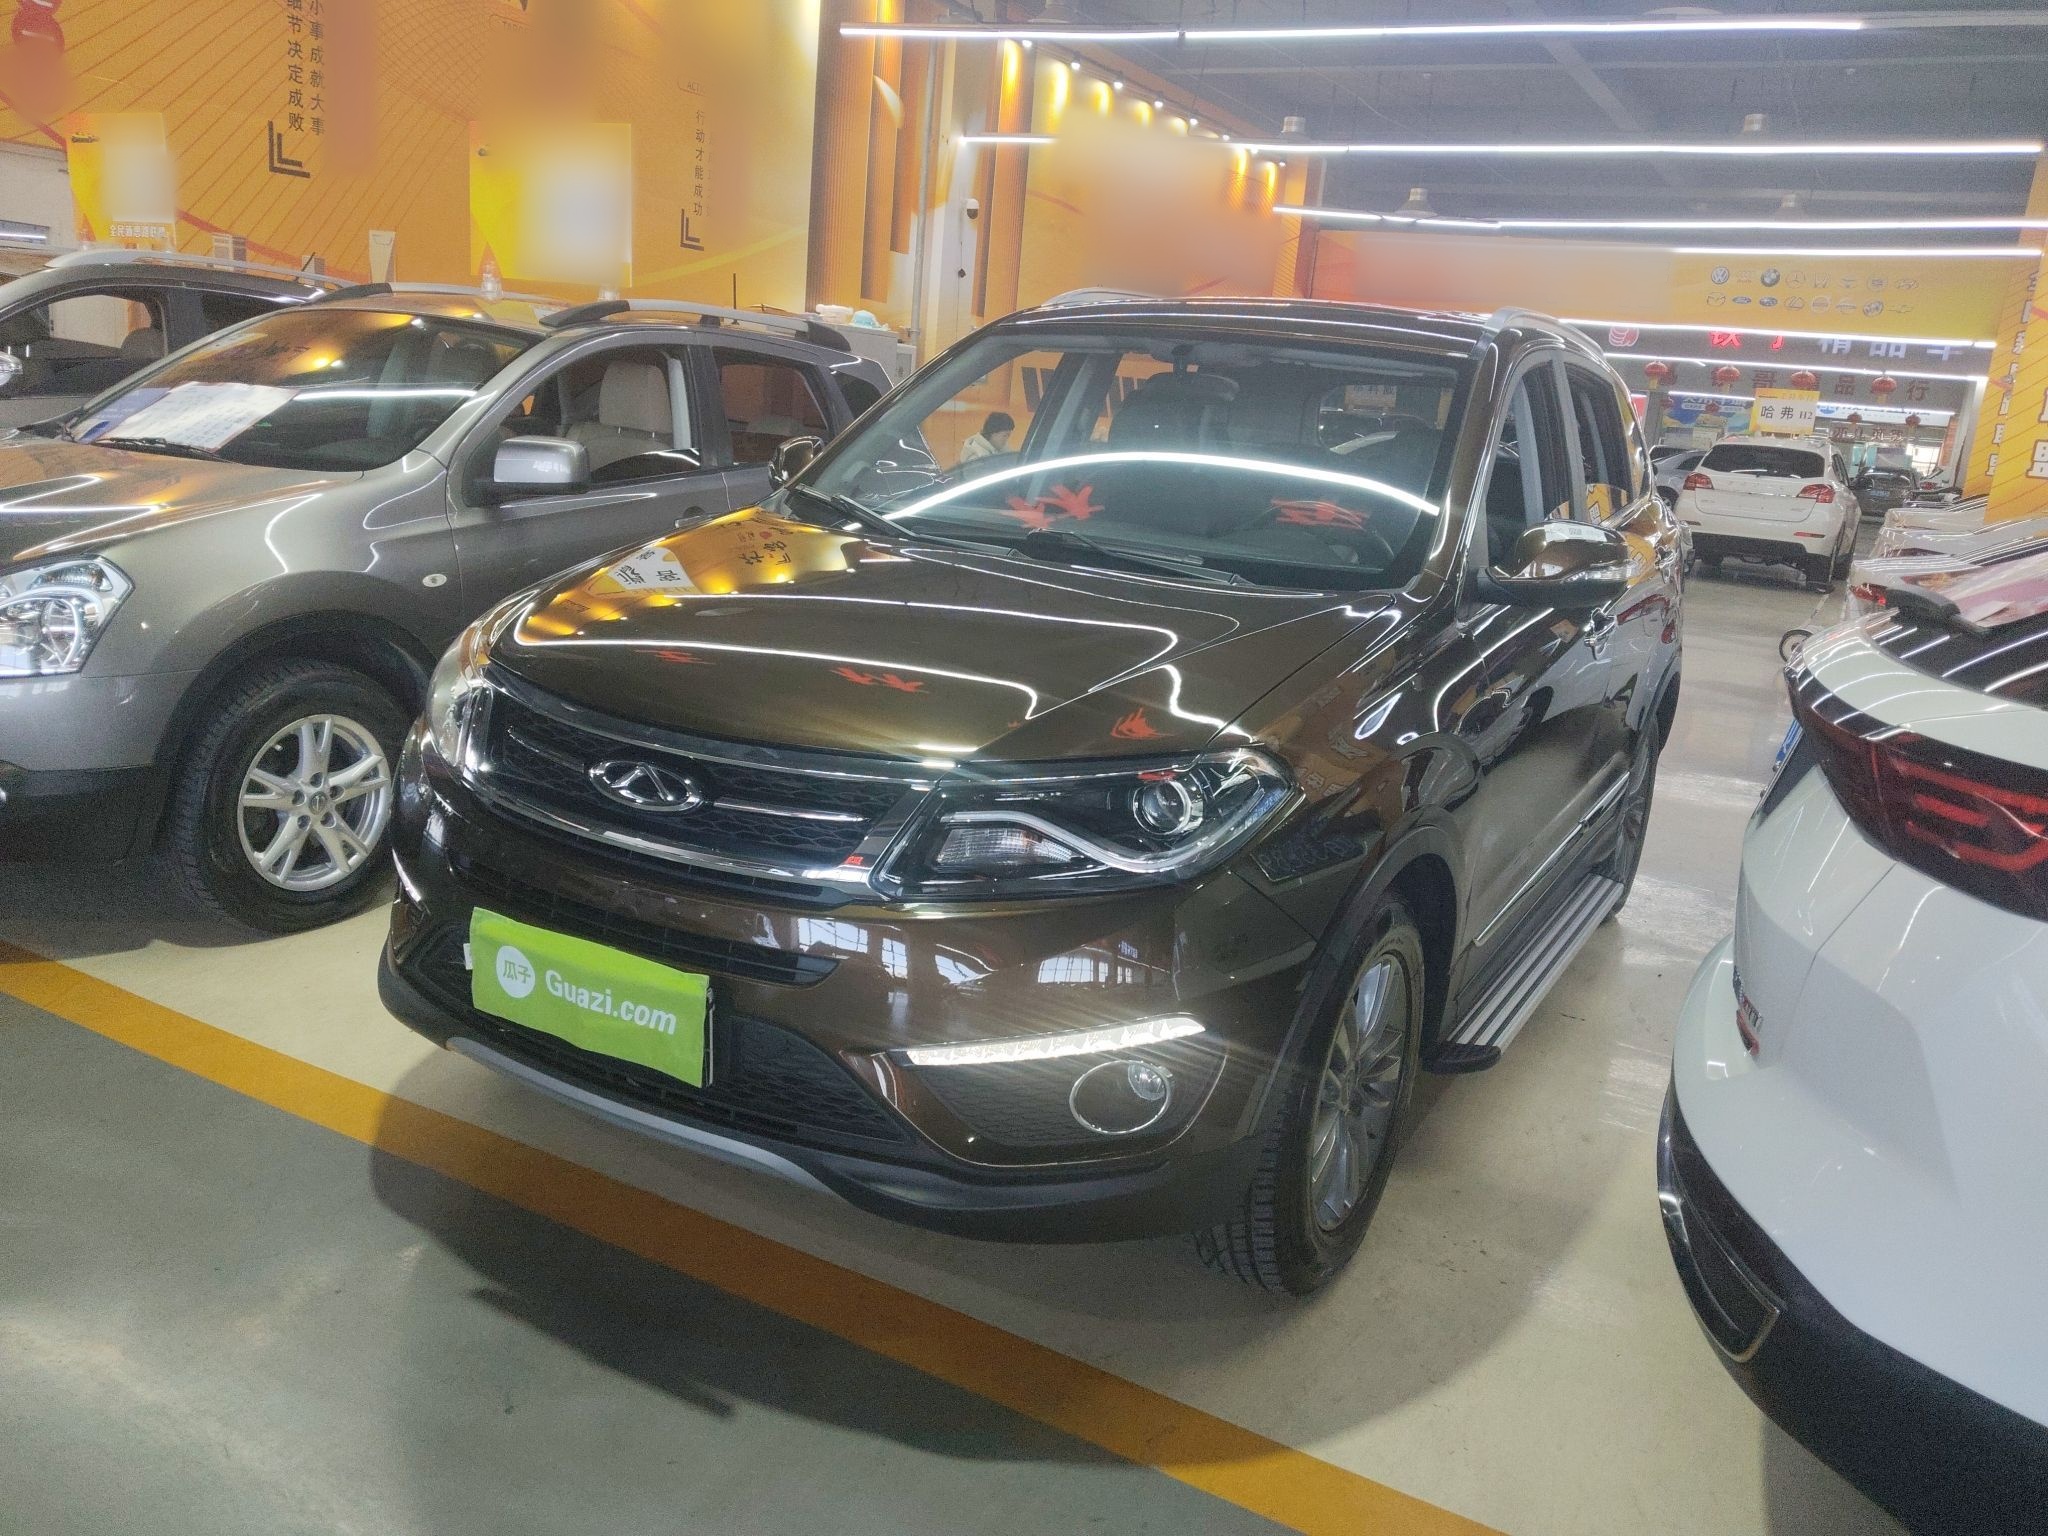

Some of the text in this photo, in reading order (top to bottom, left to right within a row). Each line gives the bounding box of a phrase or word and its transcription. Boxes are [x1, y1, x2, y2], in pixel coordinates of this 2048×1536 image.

[692, 109, 706, 217] 行动才能成功
[1761, 405, 1794, 420] 哈弗
[503, 960, 531, 984] 瓜子
[545, 969, 676, 1035] Guazi.com
